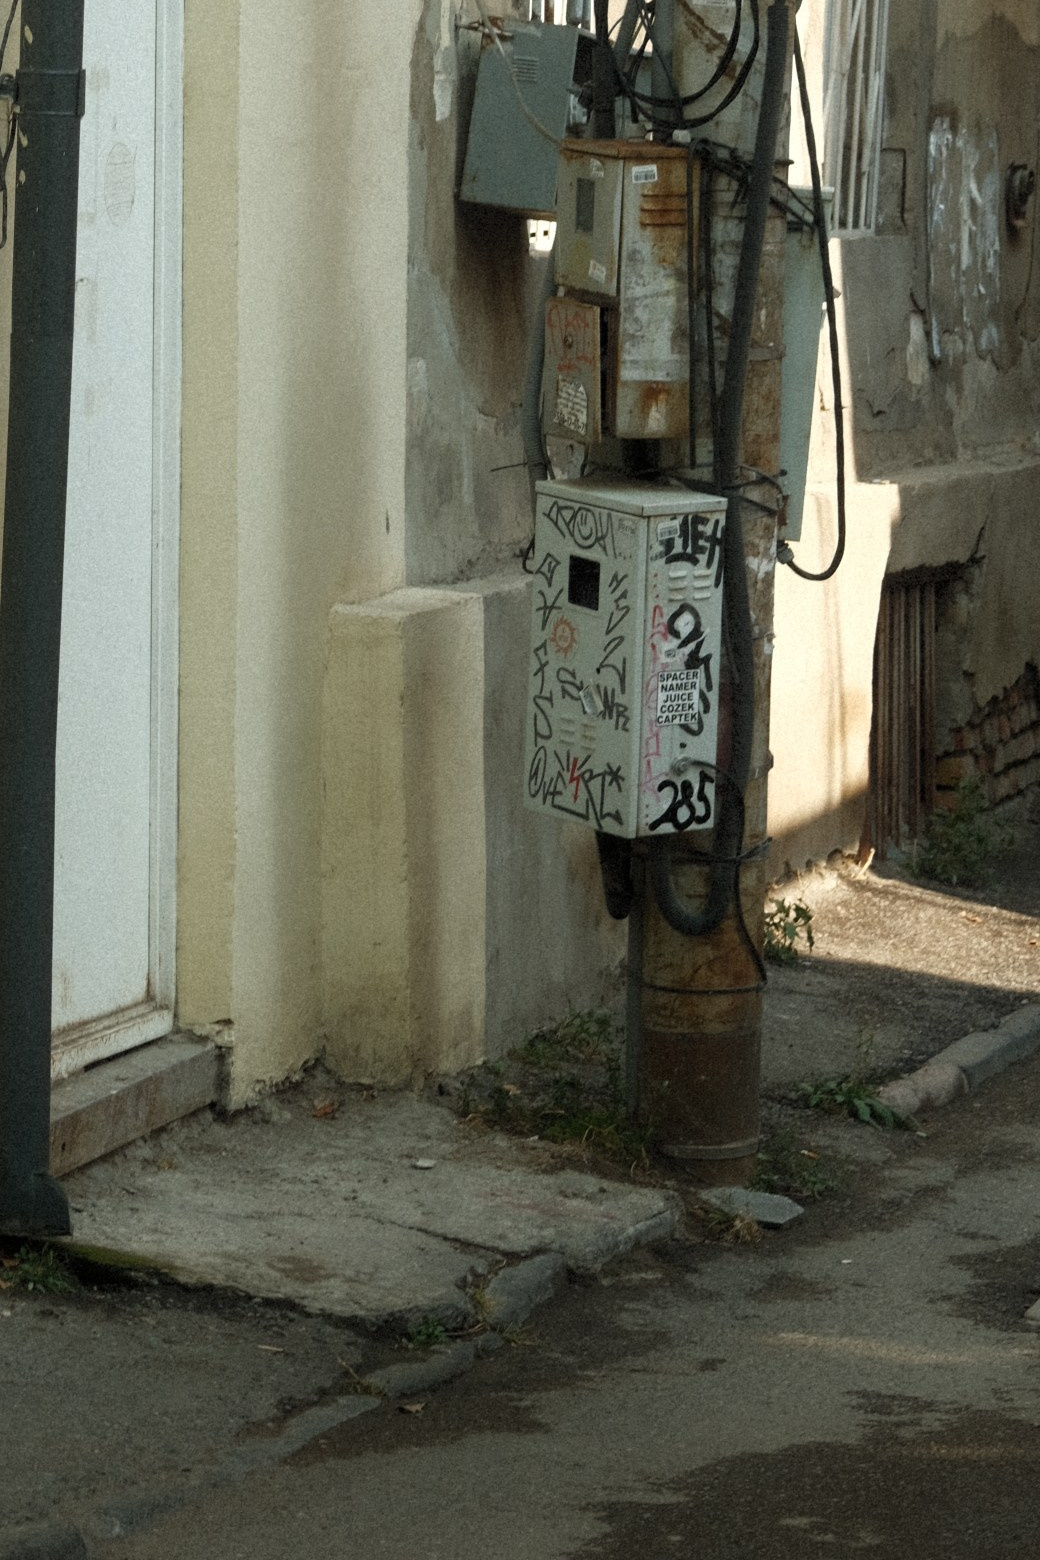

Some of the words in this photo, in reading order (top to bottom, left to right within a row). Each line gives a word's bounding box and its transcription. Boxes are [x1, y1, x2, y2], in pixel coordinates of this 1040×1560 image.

[659, 671, 699, 682] SPACER
[660, 681, 697, 692] NAMER
[663, 692, 693, 703] JUICE
[660, 703, 695, 714] COZEK
[656, 712, 698, 724] CAPTEK
